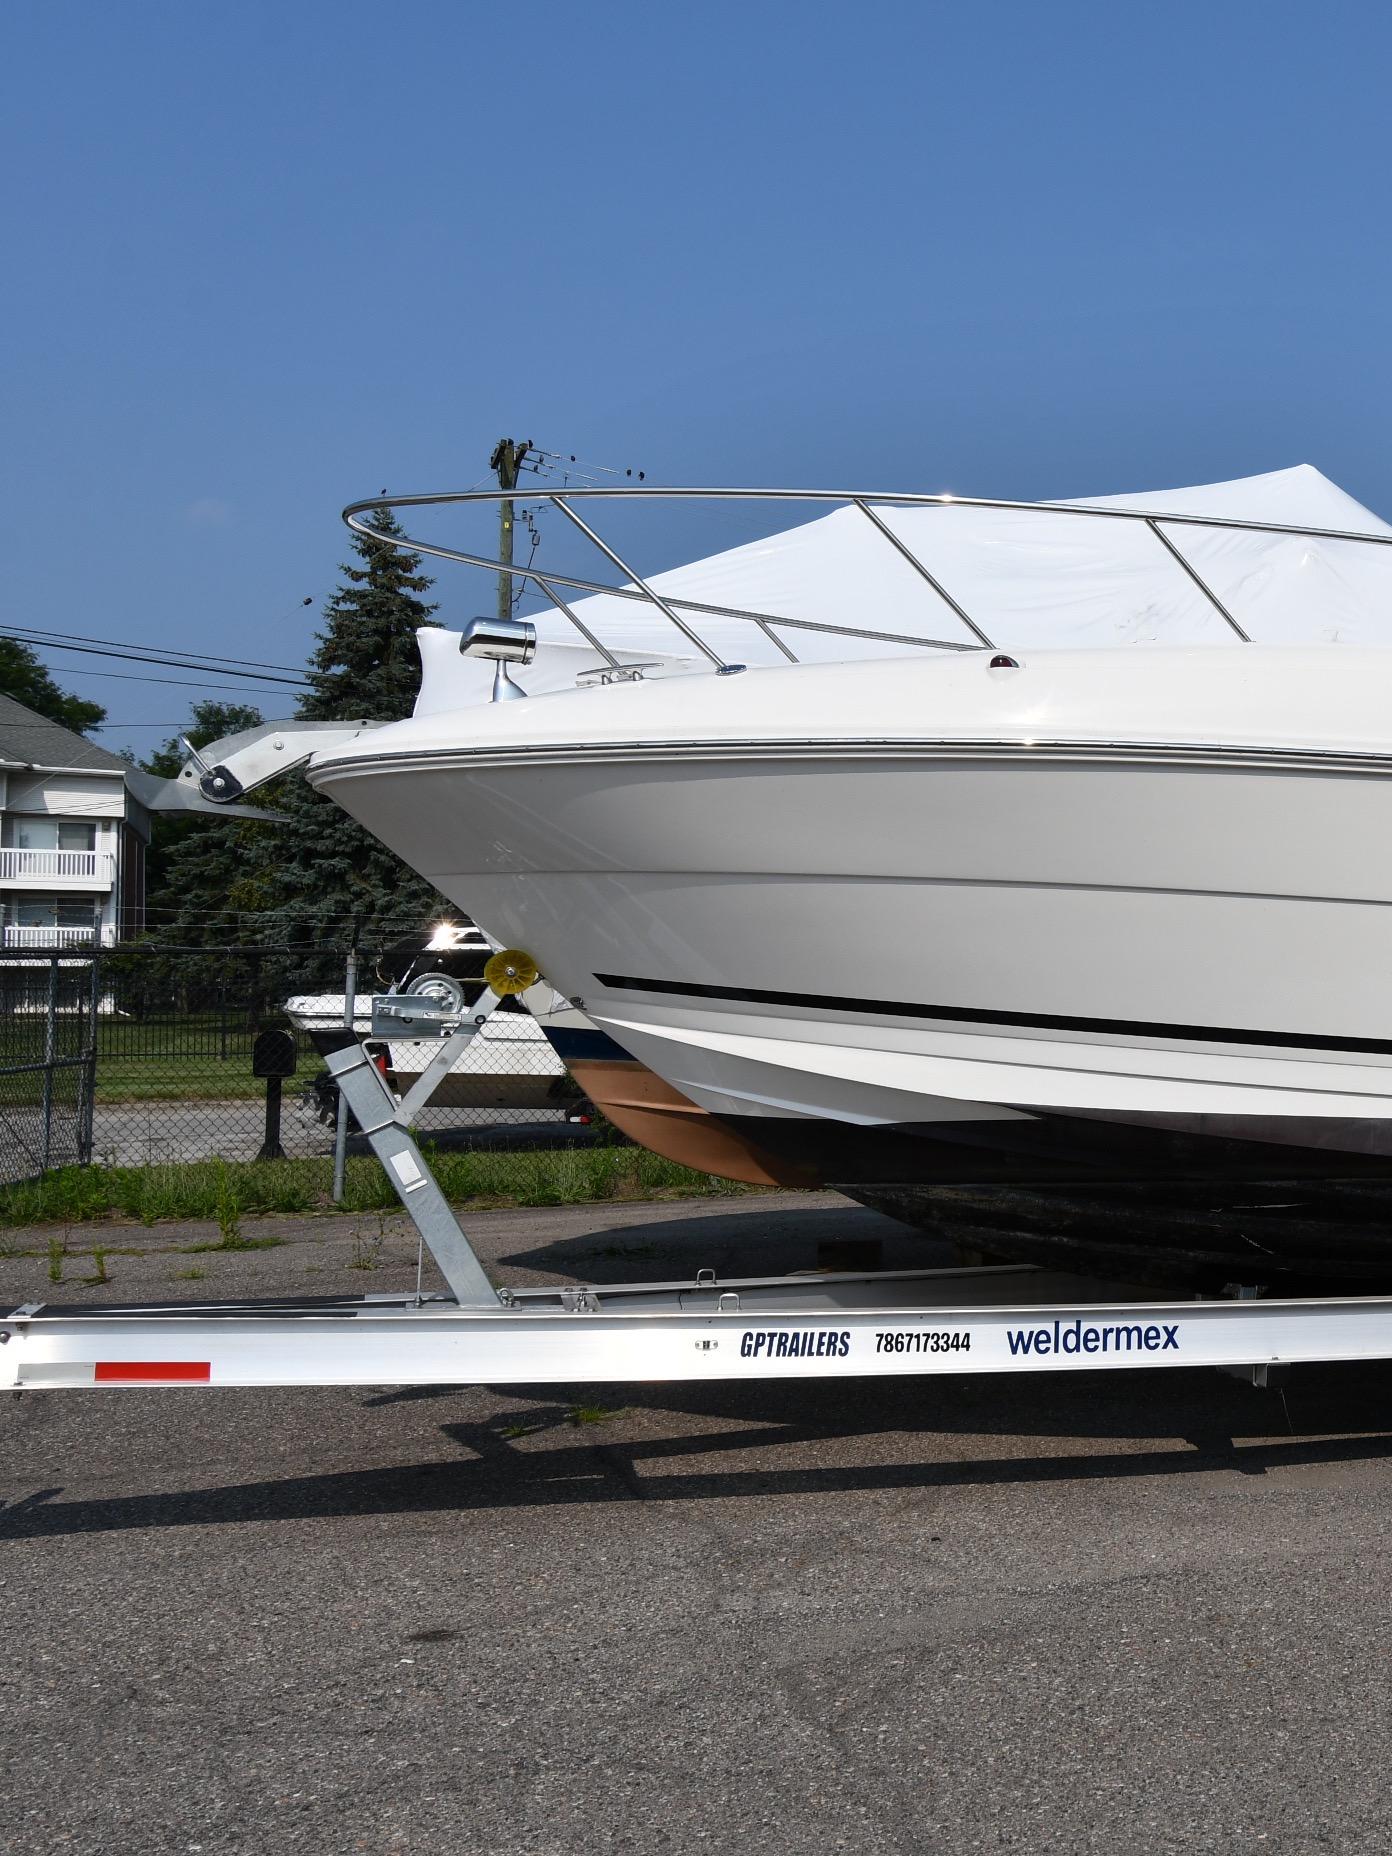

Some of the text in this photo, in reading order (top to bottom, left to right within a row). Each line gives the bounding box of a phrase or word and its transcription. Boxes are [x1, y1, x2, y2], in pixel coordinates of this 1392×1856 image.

[740, 1319, 1181, 1358] GPTRAILERS 7867173344 weldermex
